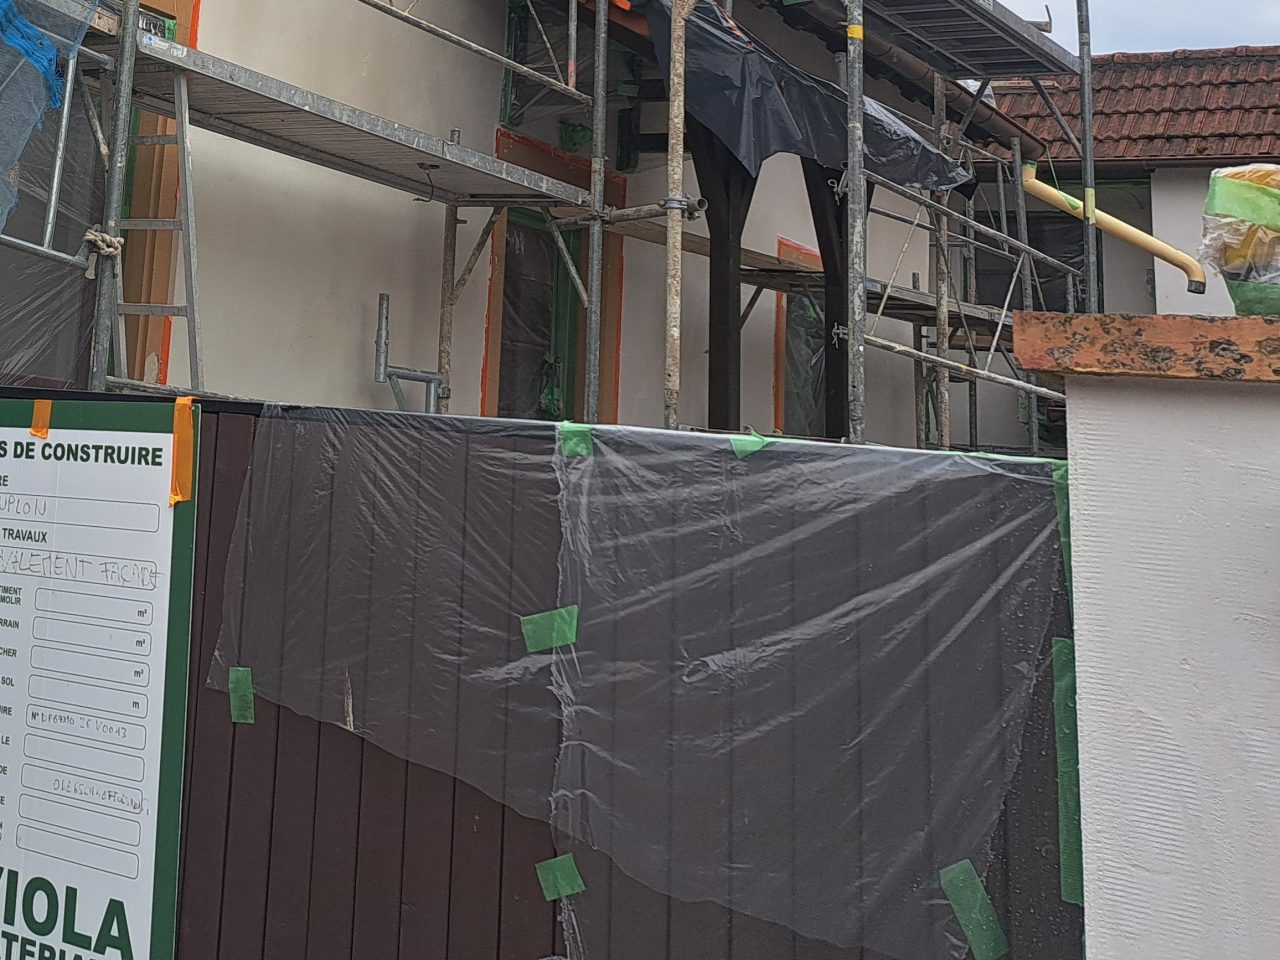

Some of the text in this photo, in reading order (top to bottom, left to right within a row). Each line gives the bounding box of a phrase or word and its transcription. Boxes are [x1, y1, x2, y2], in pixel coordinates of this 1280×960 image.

[13, 441, 36, 459] DE
[41, 442, 163, 466] CONSTRUIRE
[2, 528, 48, 543] TRAVAUX
[1, 676, 15, 687] SOL
[132, 701, 140, 709] m
[1, 736, 10, 745] LE
